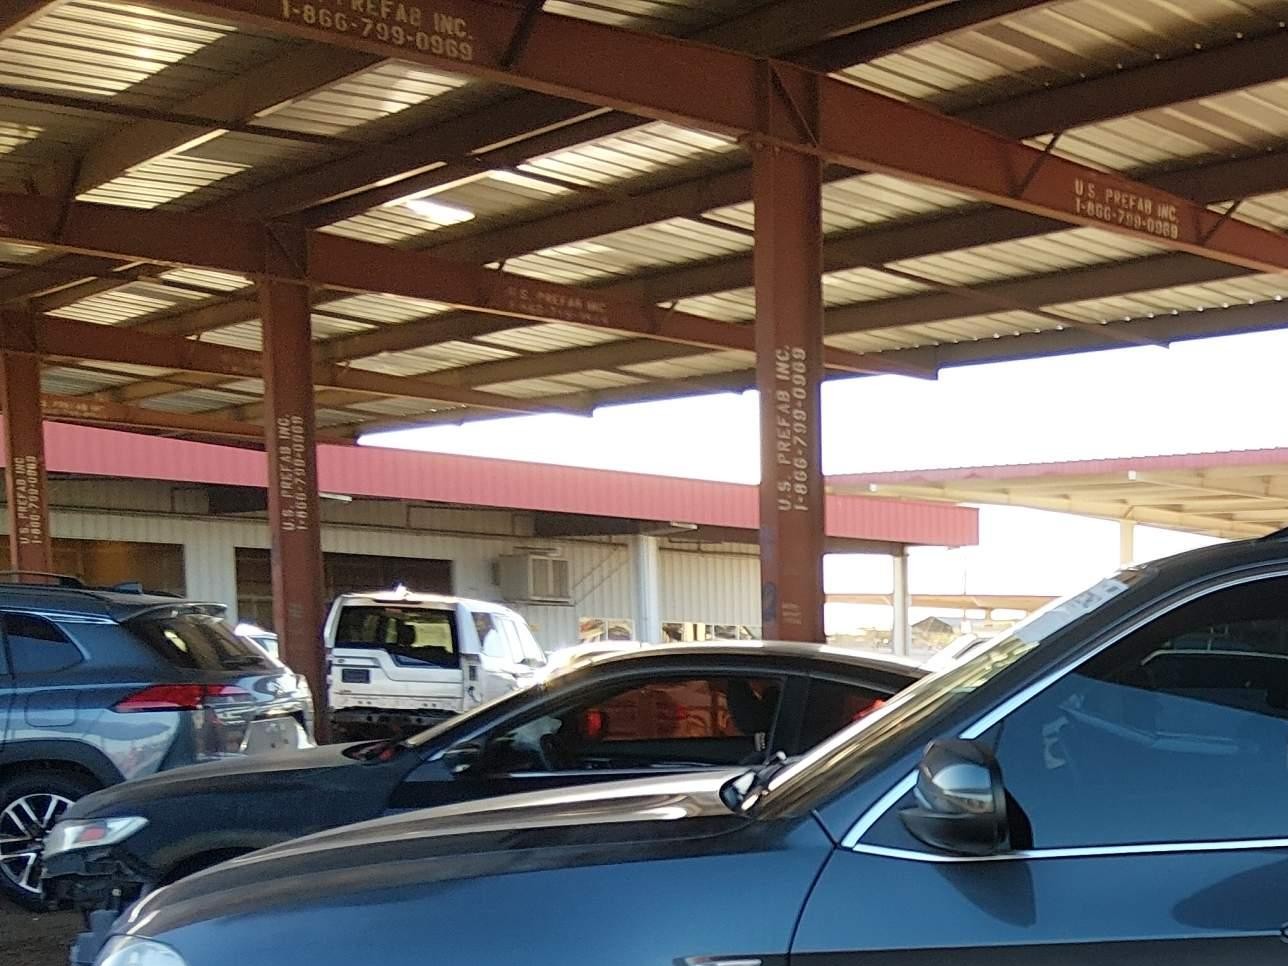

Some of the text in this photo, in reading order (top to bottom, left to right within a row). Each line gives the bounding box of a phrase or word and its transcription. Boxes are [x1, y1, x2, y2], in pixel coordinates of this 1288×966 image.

[282, 0, 473, 62] 1-866-799-0969
[337, 0, 473, 40] REFAB INC.
[1105, 188, 1152, 215] PREFAB
[775, 345, 791, 381] INC.
[776, 390, 792, 465] PREFAB
